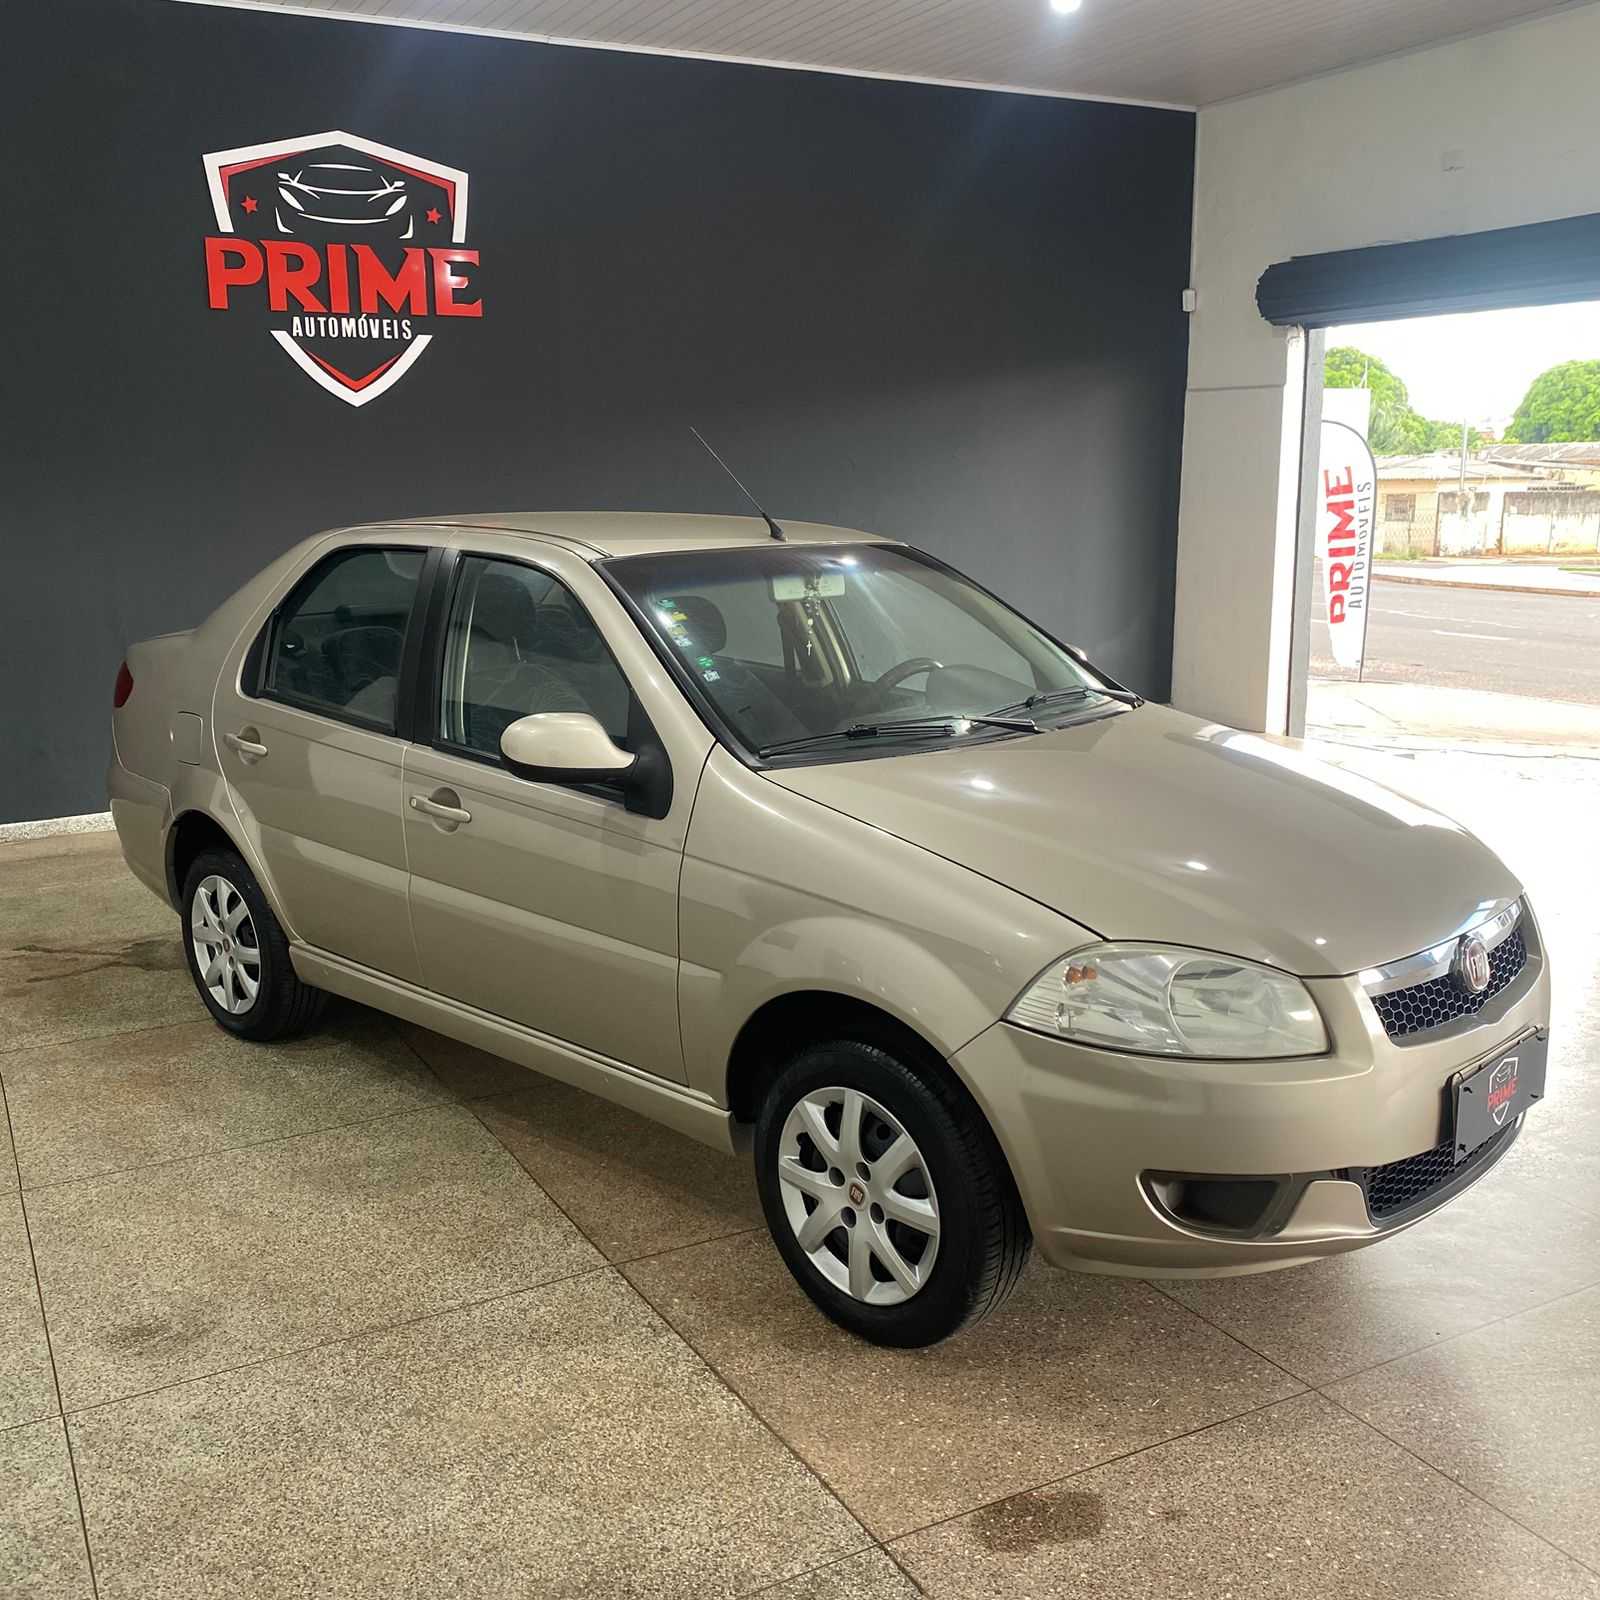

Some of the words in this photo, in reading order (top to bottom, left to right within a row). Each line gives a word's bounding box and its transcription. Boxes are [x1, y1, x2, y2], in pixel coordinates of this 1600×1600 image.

[204, 236, 483, 317] PRIME
[292, 314, 412, 340] AUTOMÓVEIS
[1324, 466, 1356, 624] PRIME
